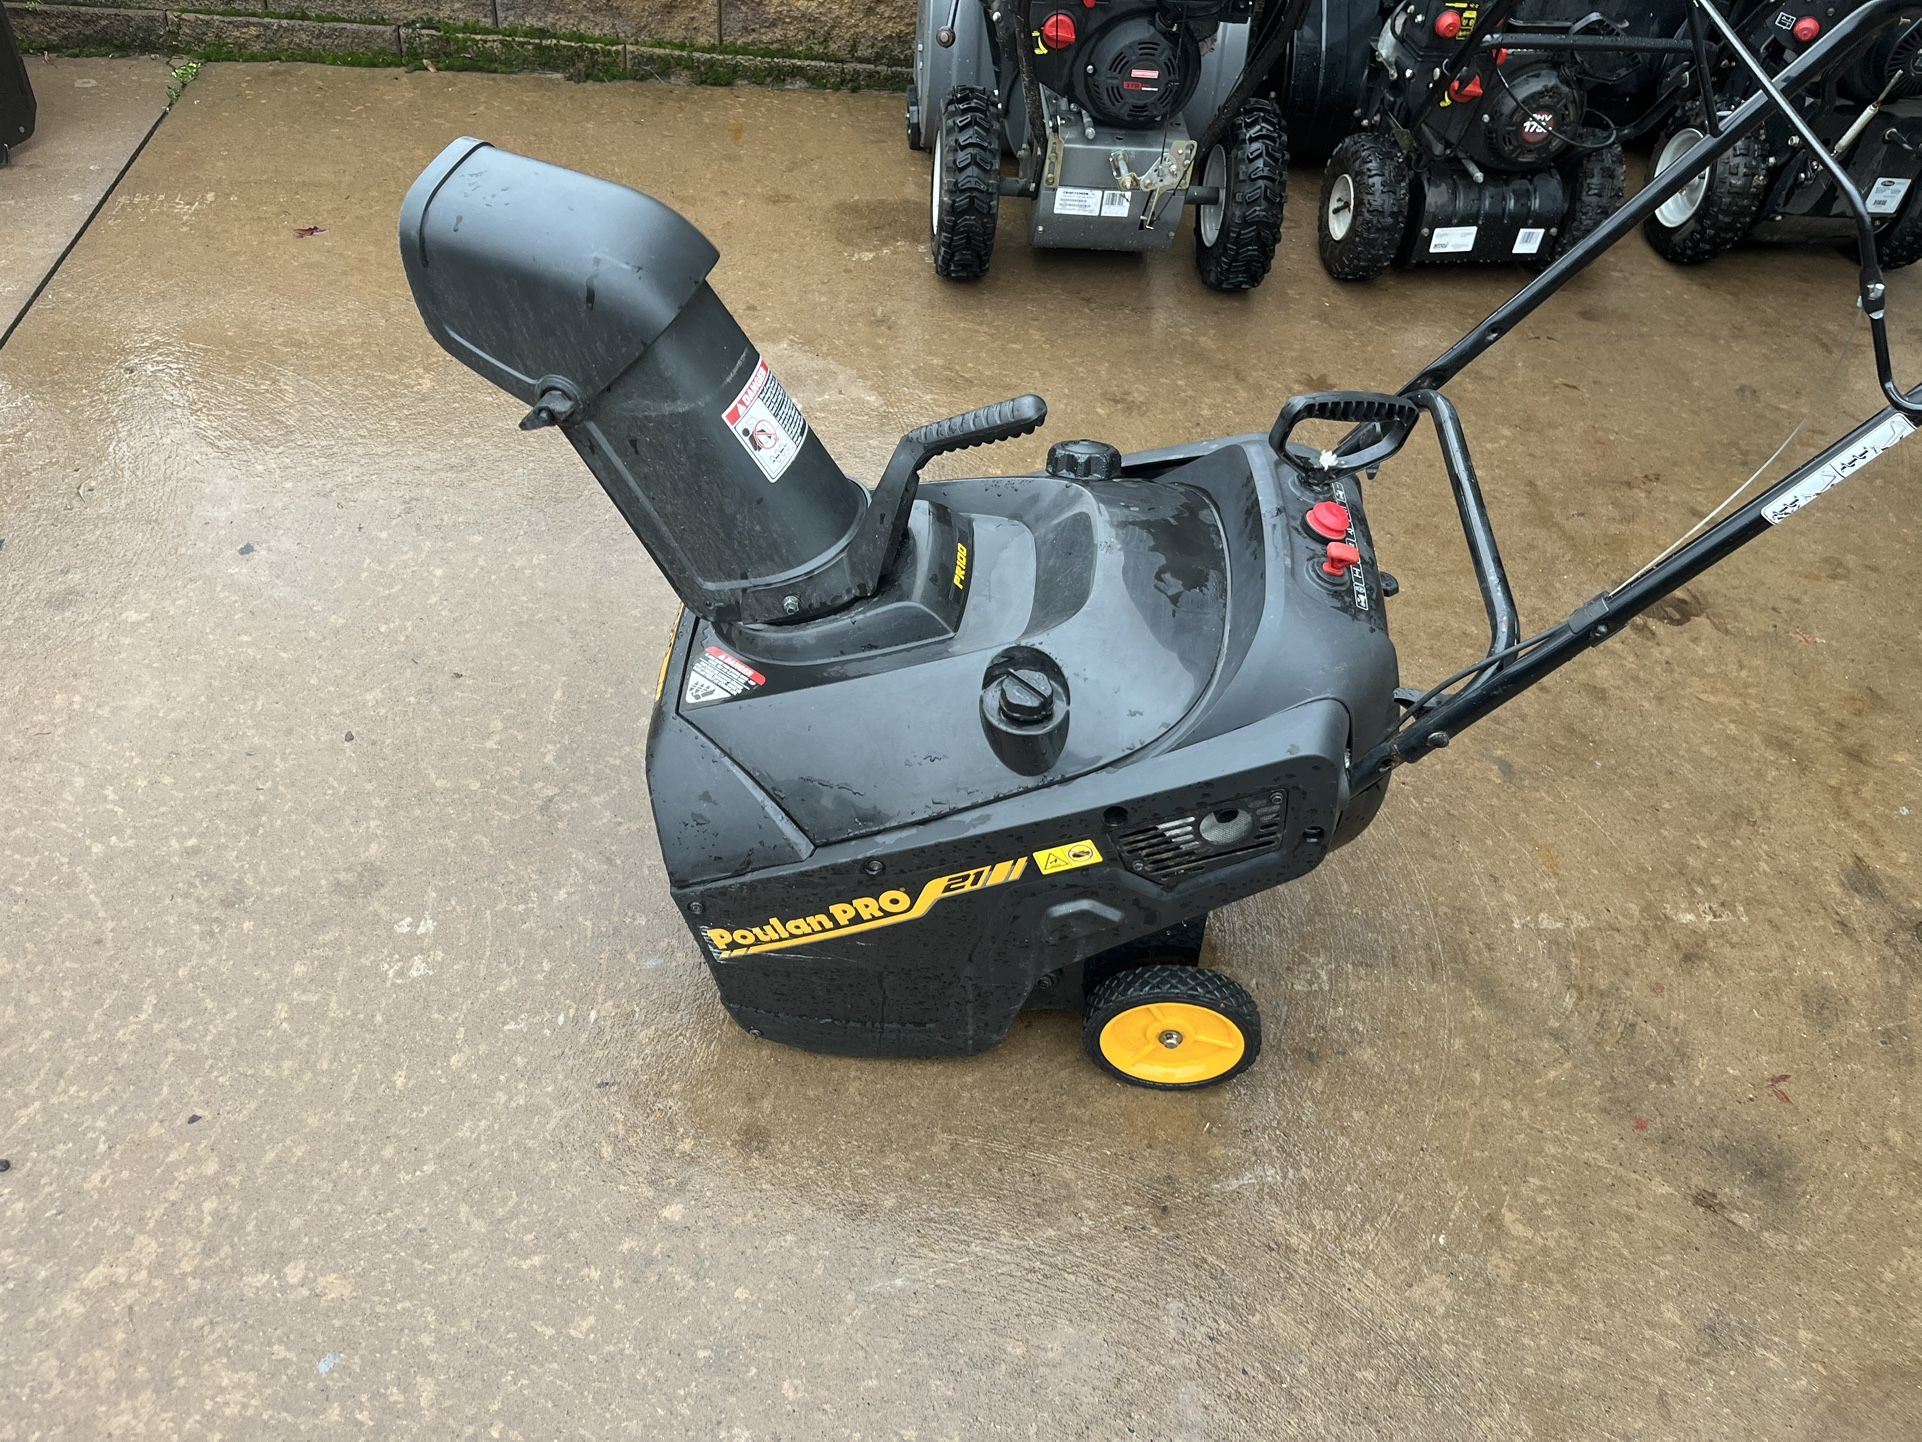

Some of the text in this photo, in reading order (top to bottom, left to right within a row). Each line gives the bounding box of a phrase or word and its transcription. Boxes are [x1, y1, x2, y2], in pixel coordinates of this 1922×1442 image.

[741, 365, 767, 408] DANGER
[723, 655, 754, 678] DANGER
[942, 870, 985, 894] 21
[706, 889, 911, 950] Poulan PRO
